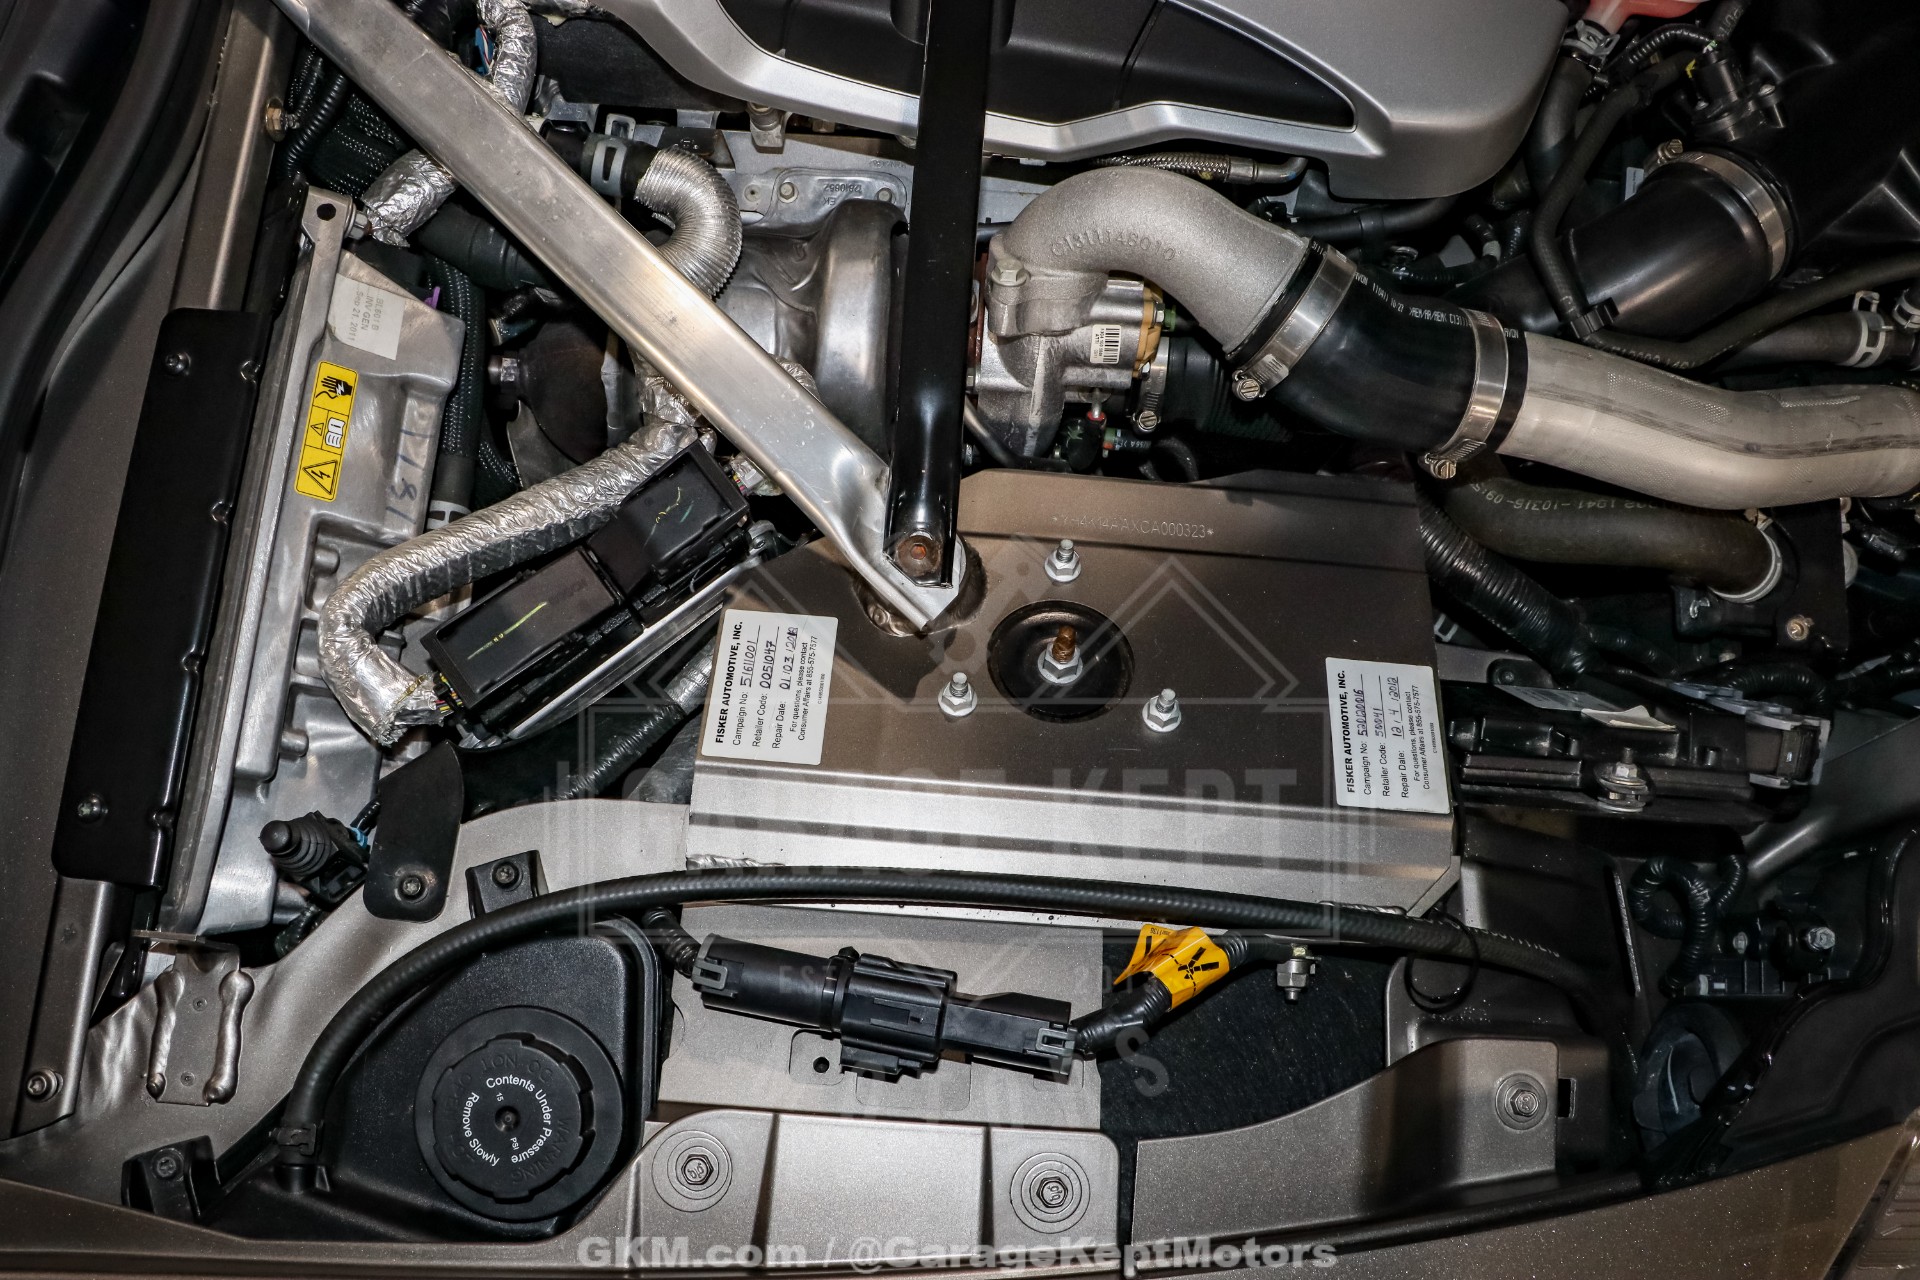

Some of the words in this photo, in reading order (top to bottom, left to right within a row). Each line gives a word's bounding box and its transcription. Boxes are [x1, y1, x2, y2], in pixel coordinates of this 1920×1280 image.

[806, 636, 818, 678] 855-575-7577
[715, 708, 729, 743] FISKER
[724, 643, 741, 706] AUTOMOTIVE,
[733, 622, 742, 639] INC.
[1338, 671, 1346, 688] INC.
[757, 692, 768, 716] Code:
[776, 701, 787, 722] Date:
[793, 690, 801, 719] questions,
[803, 687, 811, 706] Affairs
[732, 706, 747, 746] Campaign
[740, 691, 748, 705] No:
[752, 717, 764, 747] Retailer
[789, 721, 798, 732] For
[798, 708, 808, 740] Consumer
[1339, 692, 1352, 755] AUTOMOTIVE,
[771, 723, 783, 749] Repair
[1359, 740, 1368, 754] No:
[1378, 742, 1388, 765] Code:
[1398, 751, 1406, 770] Date:
[1345, 758, 1356, 793] FISKER
[1361, 756, 1373, 796] Campaign
[1380, 766, 1391, 797] Retailer
[1400, 773, 1409, 798] Repair
[1421, 757, 1430, 789] Consumer
[485, 1074, 536, 1092] Contents
[462, 1092, 480, 1138] Remove
[496, 1092, 504, 1102] 15
[510, 1137, 520, 1151] PSI
[535, 1089, 553, 1125] Under
[469, 1138, 501, 1167] Slowly
[511, 1127, 552, 1163] Pressure
